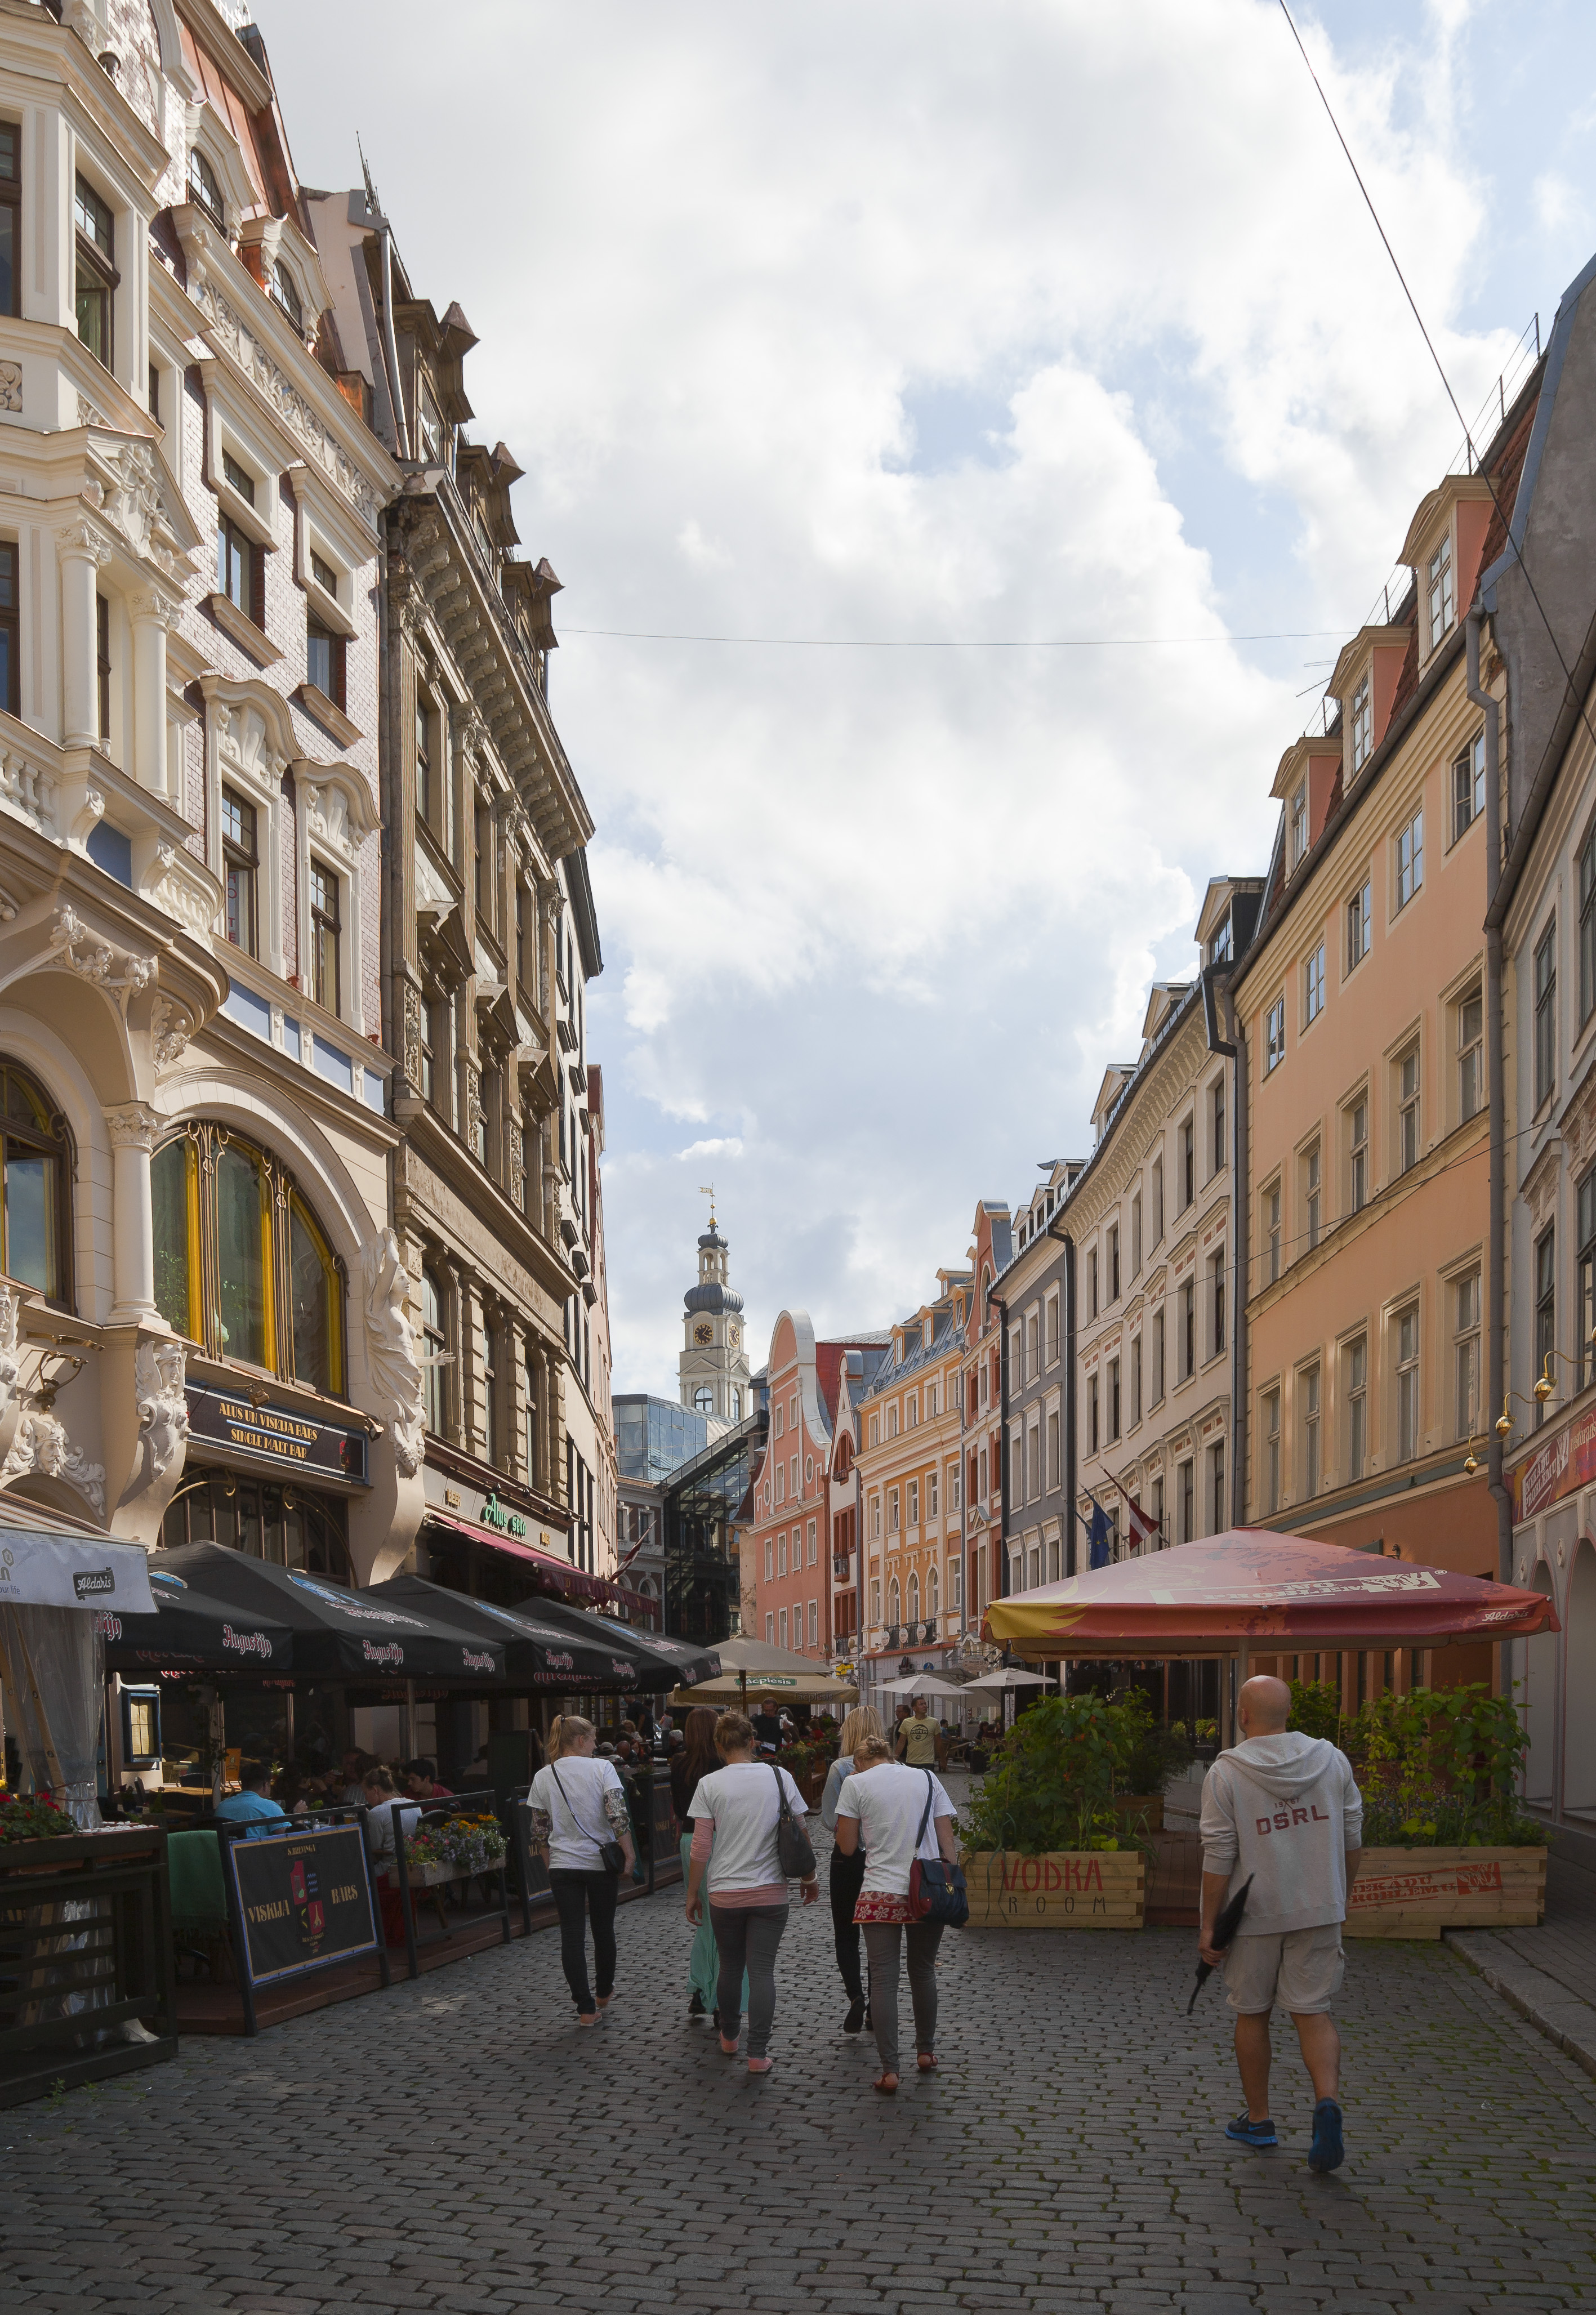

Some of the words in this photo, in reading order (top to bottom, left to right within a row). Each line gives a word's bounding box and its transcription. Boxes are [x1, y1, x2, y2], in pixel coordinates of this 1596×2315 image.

[219, 1402, 243, 1420] ALUS
[244, 1409, 258, 1424] UN
[260, 1413, 294, 1435] VISKIJA
[296, 1424, 318, 1441] BĀRS
[231, 1428, 262, 1447] SINGLE
[264, 1437, 288, 1454] MALT
[289, 1444, 307, 1458] BAR
[1525, 1450, 1550, 1495] NEKADU
[1526, 1458, 1557, 1507] PROBLEMU
[447, 1488, 461, 1507] BEER
[485, 1493, 507, 1528] Alus
[10, 1585, 20, 1594] life
[77, 1576, 112, 1591] Aldaris
[1482, 1611, 1529, 1622] Aldaris
[223, 1625, 272, 1658] Augustijn
[363, 1639, 404, 1665] Augustijn
[462, 1647, 495, 1672] Augustijn
[1256, 1805, 1329, 1835] DSRL
[1001, 1859, 1103, 1892] VODKA
[248, 1899, 290, 1924] VISKIJA
[331, 1885, 358, 1904] BĀRS
[1009, 1896, 1106, 1913] ROOM
[1349, 1883, 1455, 1903] ROBLEMU
